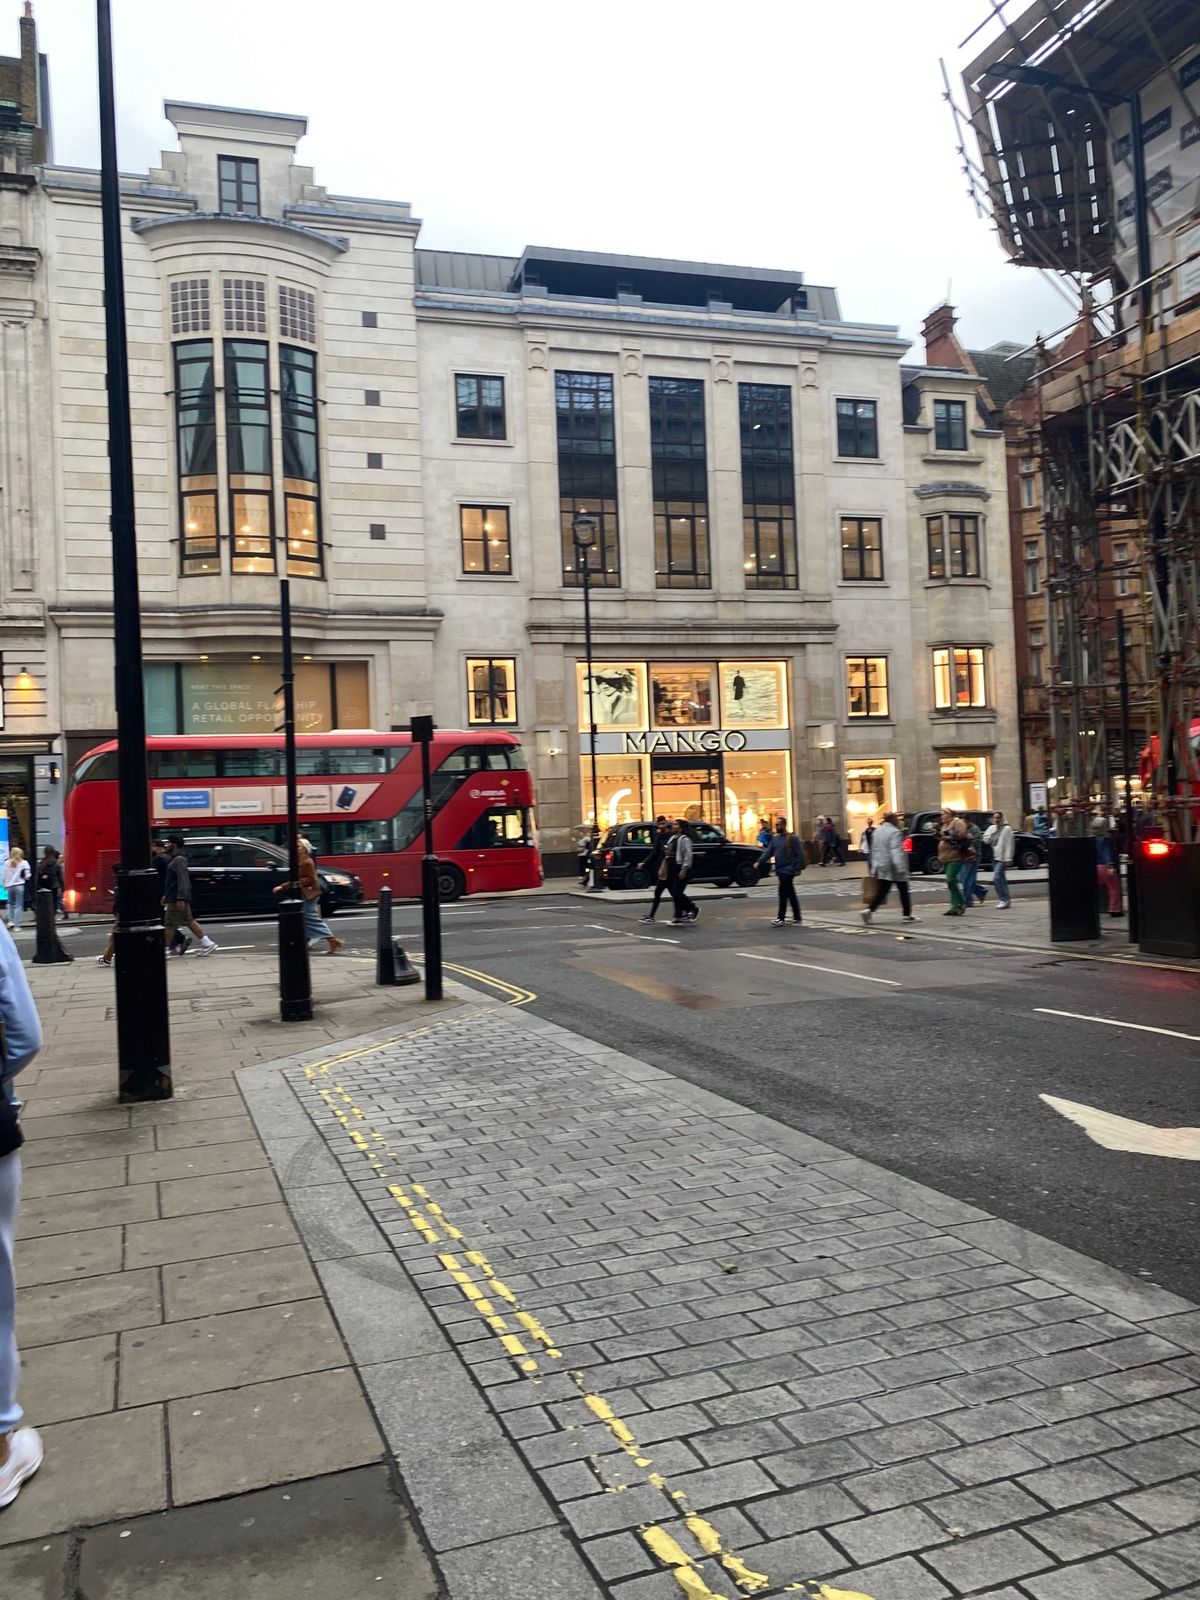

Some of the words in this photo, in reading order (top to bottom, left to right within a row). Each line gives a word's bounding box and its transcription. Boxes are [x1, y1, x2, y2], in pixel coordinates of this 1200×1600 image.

[191, 701, 200, 711] A
[204, 701, 253, 711] GLOBAL
[257, 700, 317, 710] FLAHIP
[192, 714, 235, 723] RETAIL
[621, 730, 747, 753] MANGO
